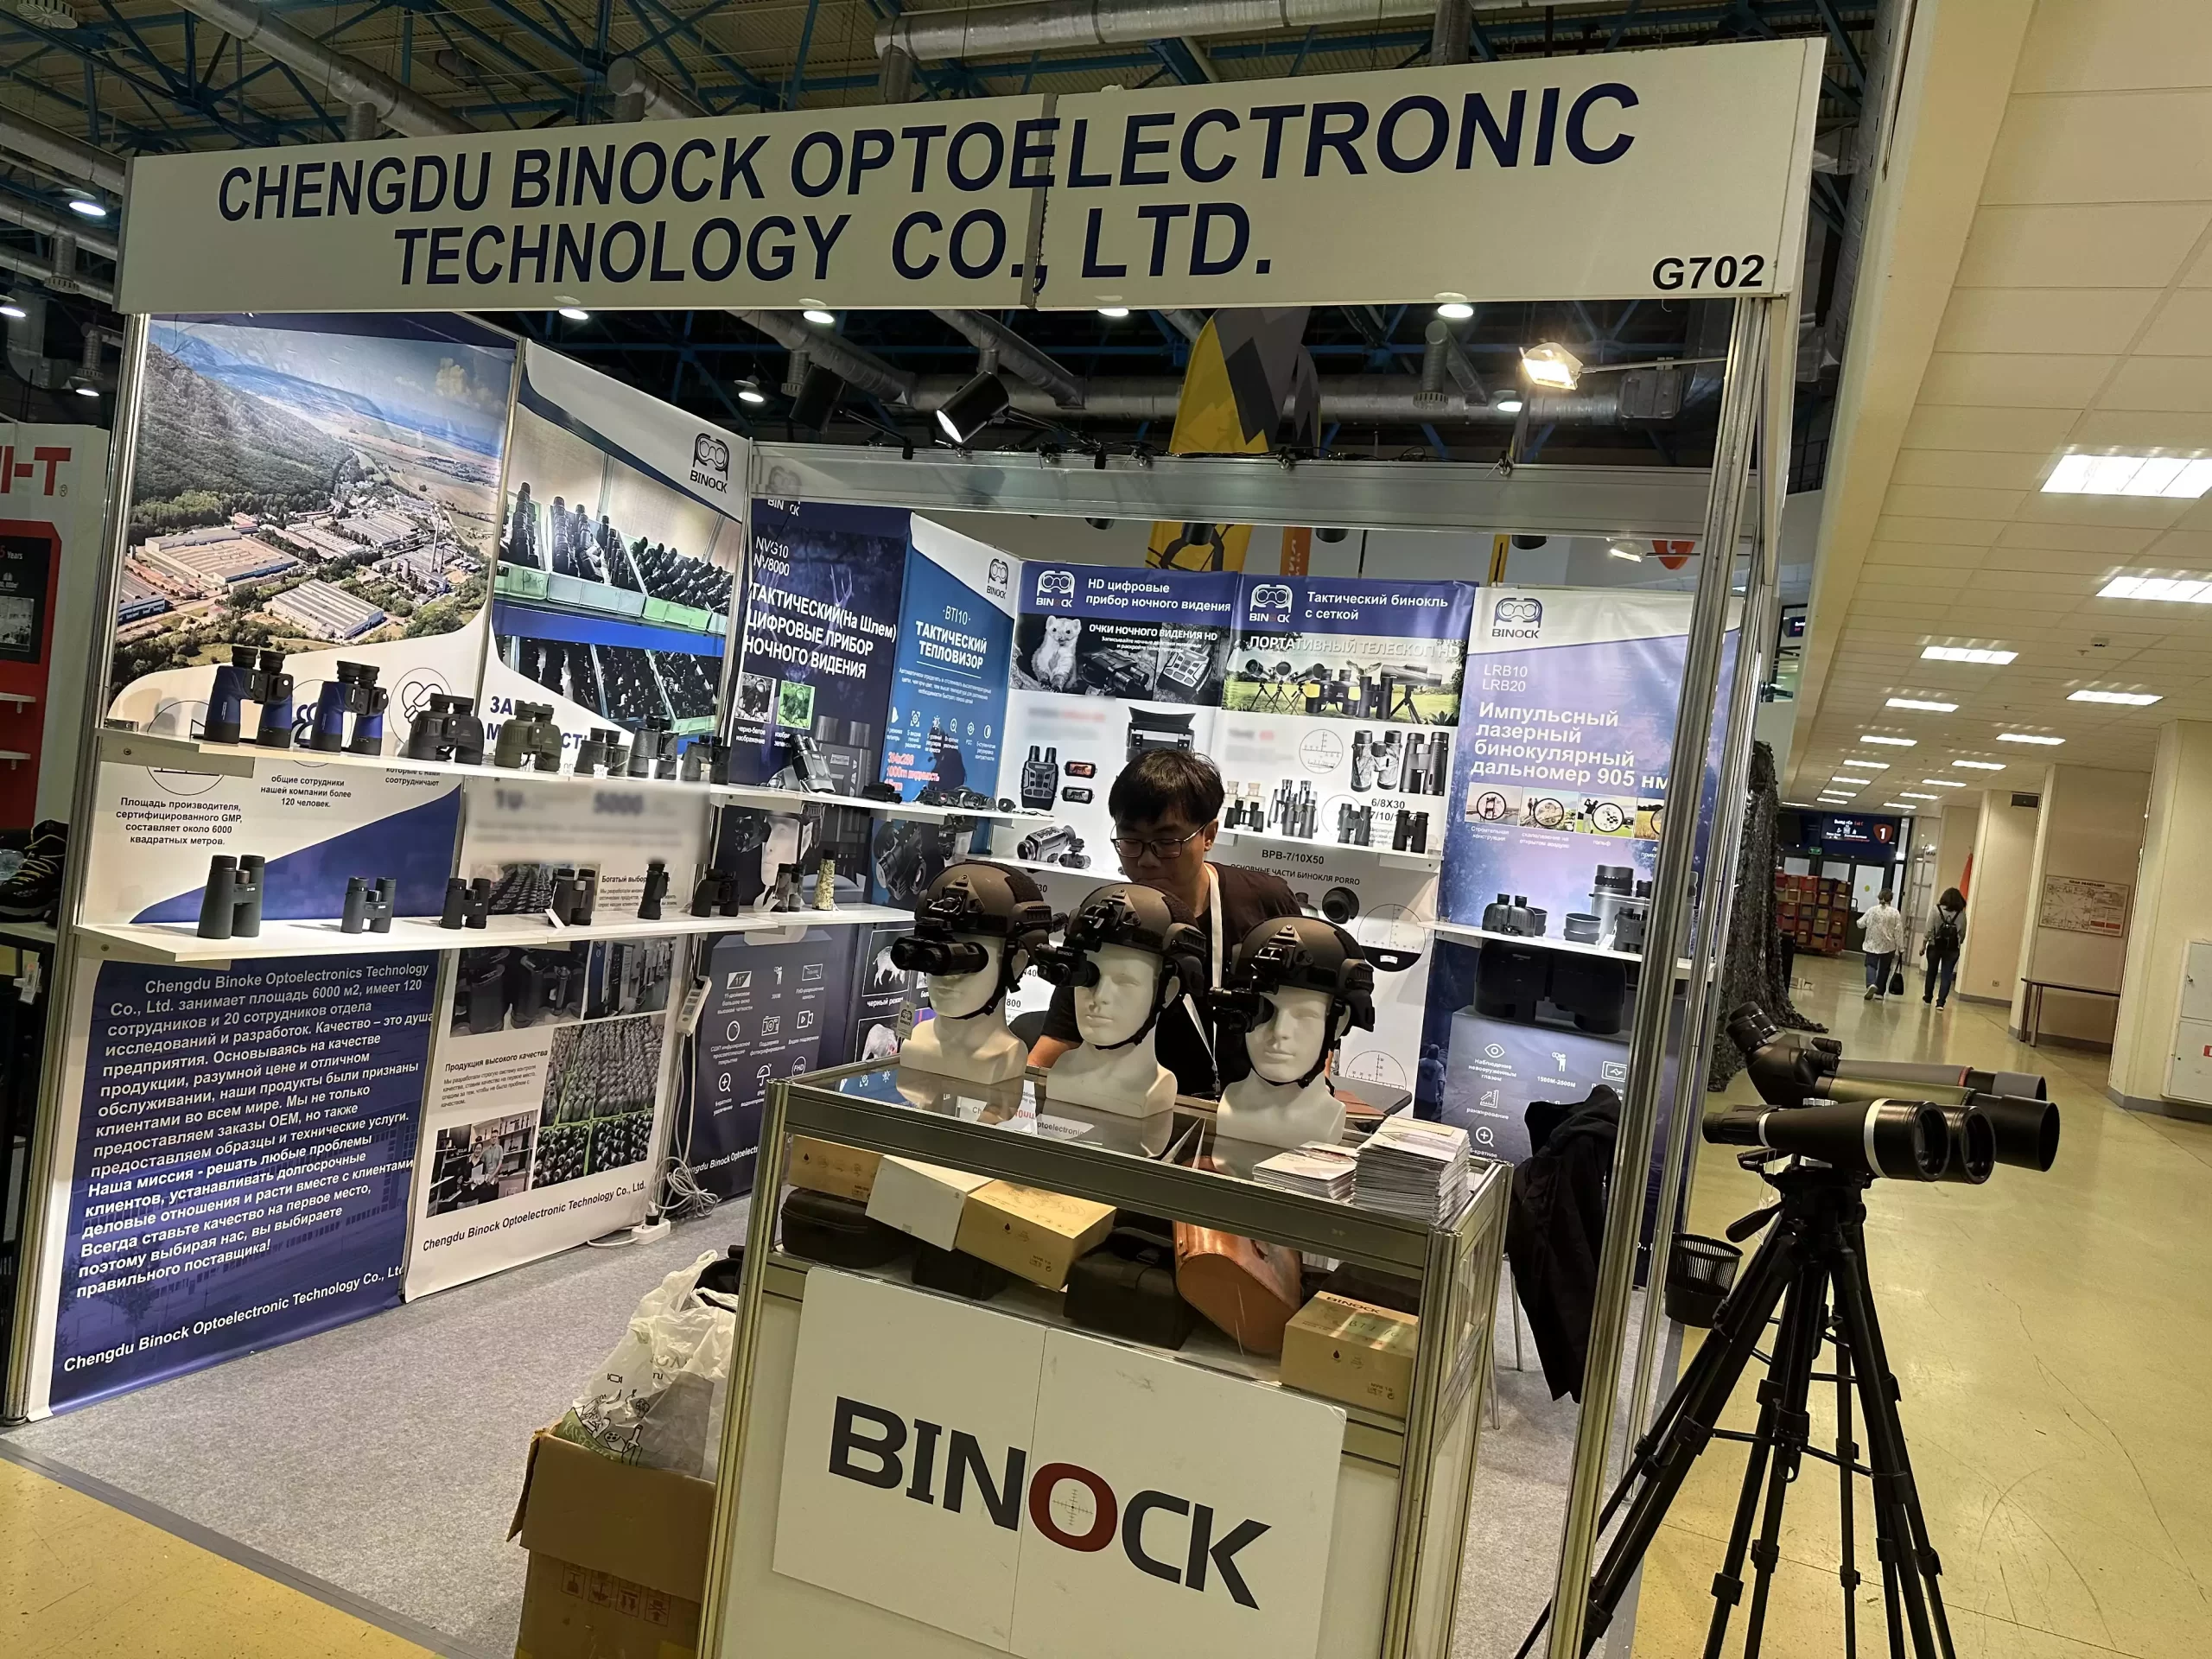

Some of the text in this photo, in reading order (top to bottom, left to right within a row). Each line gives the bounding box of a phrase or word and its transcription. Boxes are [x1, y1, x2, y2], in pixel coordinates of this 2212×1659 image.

[219, 82, 1641, 222] CHENGDU BINOCK OPTOELECTRONIC
[394, 203, 1272, 294] TECHNOLOGY CO., LTD.
[1652, 254, 1765, 290] G702
[690, 470, 728, 493] BINOCK
[756, 536, 788, 559] NVG10
[753, 553, 790, 576] NV8000
[987, 586, 1007, 599] BINOCK
[1089, 579, 1170, 594] HD цифровые
[1086, 595, 1230, 612] прибор ночного видения
[1307, 591, 1448, 607] Тактический бинокль
[1316, 610, 1358, 620] сеткой
[747, 609, 874, 657] ЦИФРОВЫЕ ПРИБОР
[861, 615, 897, 642] Шлем)
[916, 620, 987, 654] ТАКТИЧЕСКИЙ
[1090, 624, 1114, 633] ОЧКИ
[1116, 626, 1157, 637] НОЧНОГО
[1160, 629, 1202, 640] ВИДЕНИЯ
[1492, 628, 1540, 639] BINOCK
[745, 635, 867, 679] НОЧНОГО ВИДЕНИЯ
[918, 641, 983, 670] ТЕПЛОВИЗОР
[1250, 636, 1459, 658] ПОРТАТИВНЫЙ ТЕЛЕСКОП HD
[1484, 664, 1528, 677] LRB10
[1482, 679, 1526, 692] LRB20
[1479, 702, 1619, 727] Импульсный
[1476, 724, 1581, 744] лазерный
[1474, 740, 1635, 767] бинокулярный
[271, 775, 345, 789] общие сотрудники
[1471, 761, 1591, 786] дальномер
[1597, 768, 1635, 787] 905
[260, 785, 352, 799] нашей компании более
[281, 798, 295, 808] 120
[121, 797, 241, 812] Площадь производителя,
[1371, 798, 1405, 810] 6/8X30
[116, 810, 243, 824] сертифицированного GMP,
[125, 823, 232, 835] составляет около 6000
[1880, 828, 1885, 840] 1
[130, 836, 226, 847] квадратных метров.
[1262, 849, 1325, 865] BPB-7/10X50
[1272, 868, 1296, 878] ЧАСТИ
[1297, 872, 1333, 882] БИНОКЛЯ
[1335, 875, 1360, 886] PORRO
[145, 964, 429, 994] Chengdu Binoke Optoelectronics Technology
[111, 979, 423, 1017] Co., Ltd. занимает площадь 6000 м2, имеет 120
[108, 1001, 372, 1037] сотрудников и 20 сотрудников отдела
[105, 1034, 217, 1057] исследований
[220, 1033, 229, 1044] и
[232, 1025, 311, 1046] разработок.
[315, 1017, 372, 1033] Качество
[383, 1014, 403, 1027] это
[103, 1034, 381, 1078] предприятия. Основываясь на качестве
[445, 1050, 548, 1072] Продукция высокого качества
[1474, 1058, 1512, 1070] Наблюдение
[100, 1052, 371, 1100] продукции, разумной цене и отличном
[88, 1135, 372, 1197] Наша миссия решать любые проблемы
[710, 1155, 730, 1169] Binock
[85, 1152, 366, 1218] клиентов, устанавливать долгосрочные
[423, 1179, 646, 1252] Chengdu Binock Optoelectronic Technology Co., Ltd.
[79, 1206, 343, 1279] поэтому выбирая нас, вы выбираете
[76, 1239, 271, 1299] правильного поставщика!
[1326, 1296, 1381, 1314] BINOCK
[64, 1342, 135, 1372] Chengdu
[138, 1325, 190, 1351] Binock
[193, 1298, 289, 1335] Optoelectronic
[293, 1275, 360, 1306] Technology
[363, 1273, 385, 1285] Co.,
[828, 1395, 1272, 1610] BINOCK
